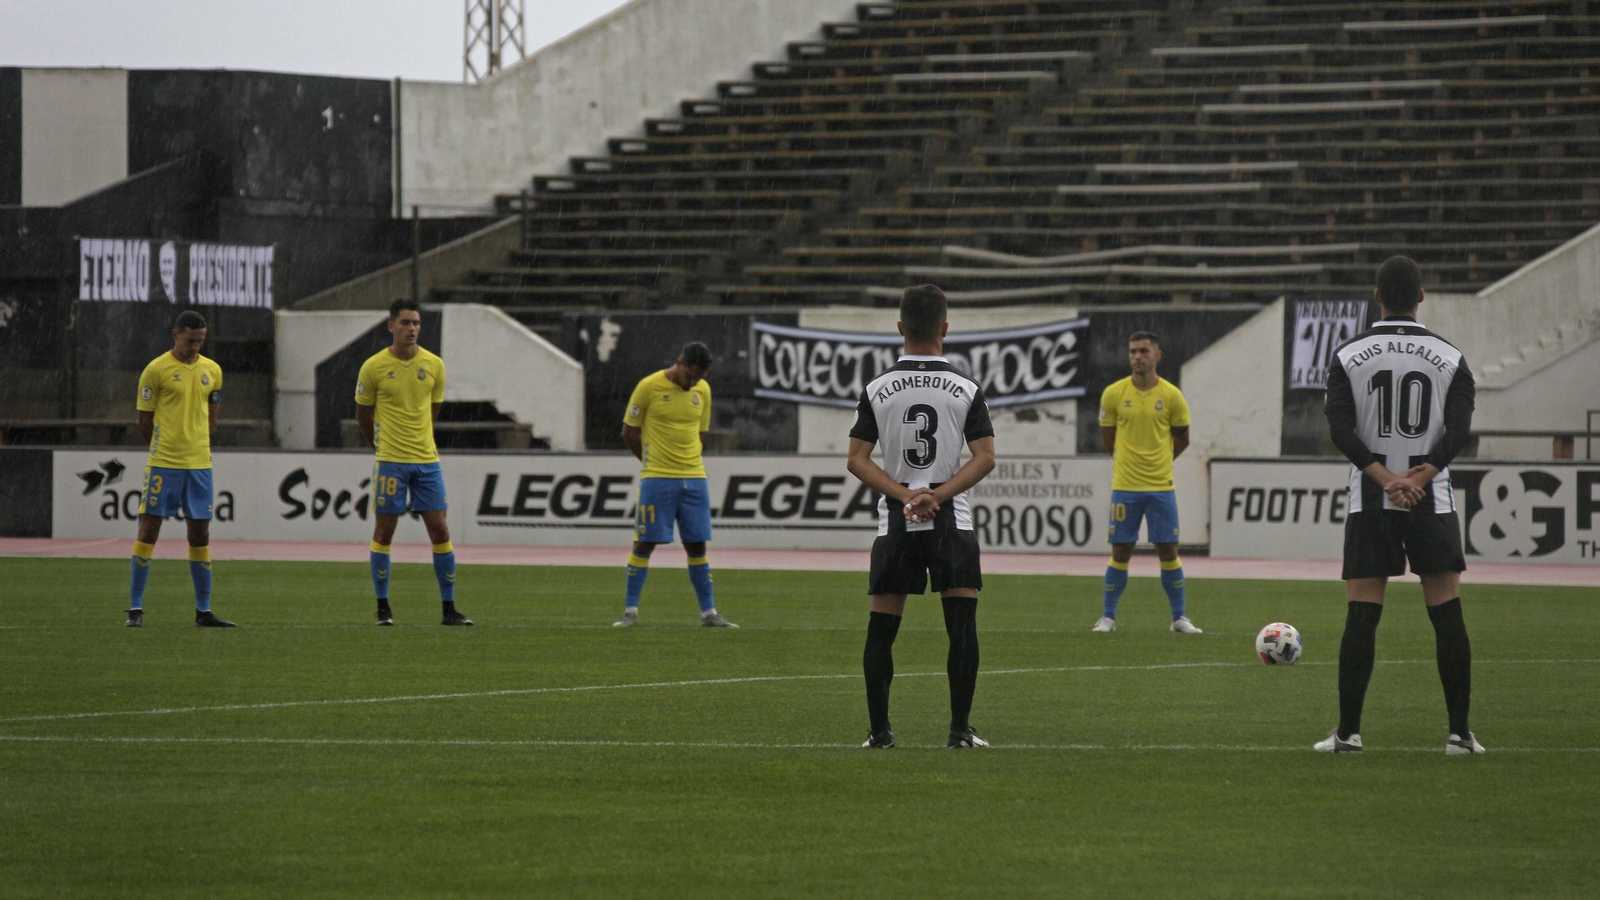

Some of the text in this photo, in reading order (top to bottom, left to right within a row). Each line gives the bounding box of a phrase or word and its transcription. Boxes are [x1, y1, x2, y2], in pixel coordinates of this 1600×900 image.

[80, 239, 274, 309] ETERNO PRESIDENTE
[1352, 342, 1448, 372] LUIS ALCALDE
[878, 376, 963, 403] ALOMEROVIC
[1368, 370, 1432, 439] 10
[903, 404, 938, 469] 3
[151, 475, 163, 494] 3
[379, 475, 398, 496] 18
[1050, 463, 1062, 480] Y
[477, 473, 637, 519] LEGE
[711, 475, 878, 520] EGEA
[1110, 503, 1126, 522] 10
[1226, 487, 1349, 524] FOOTTE
[640, 505, 655, 524] 11
[972, 505, 1092, 546] RROSO
